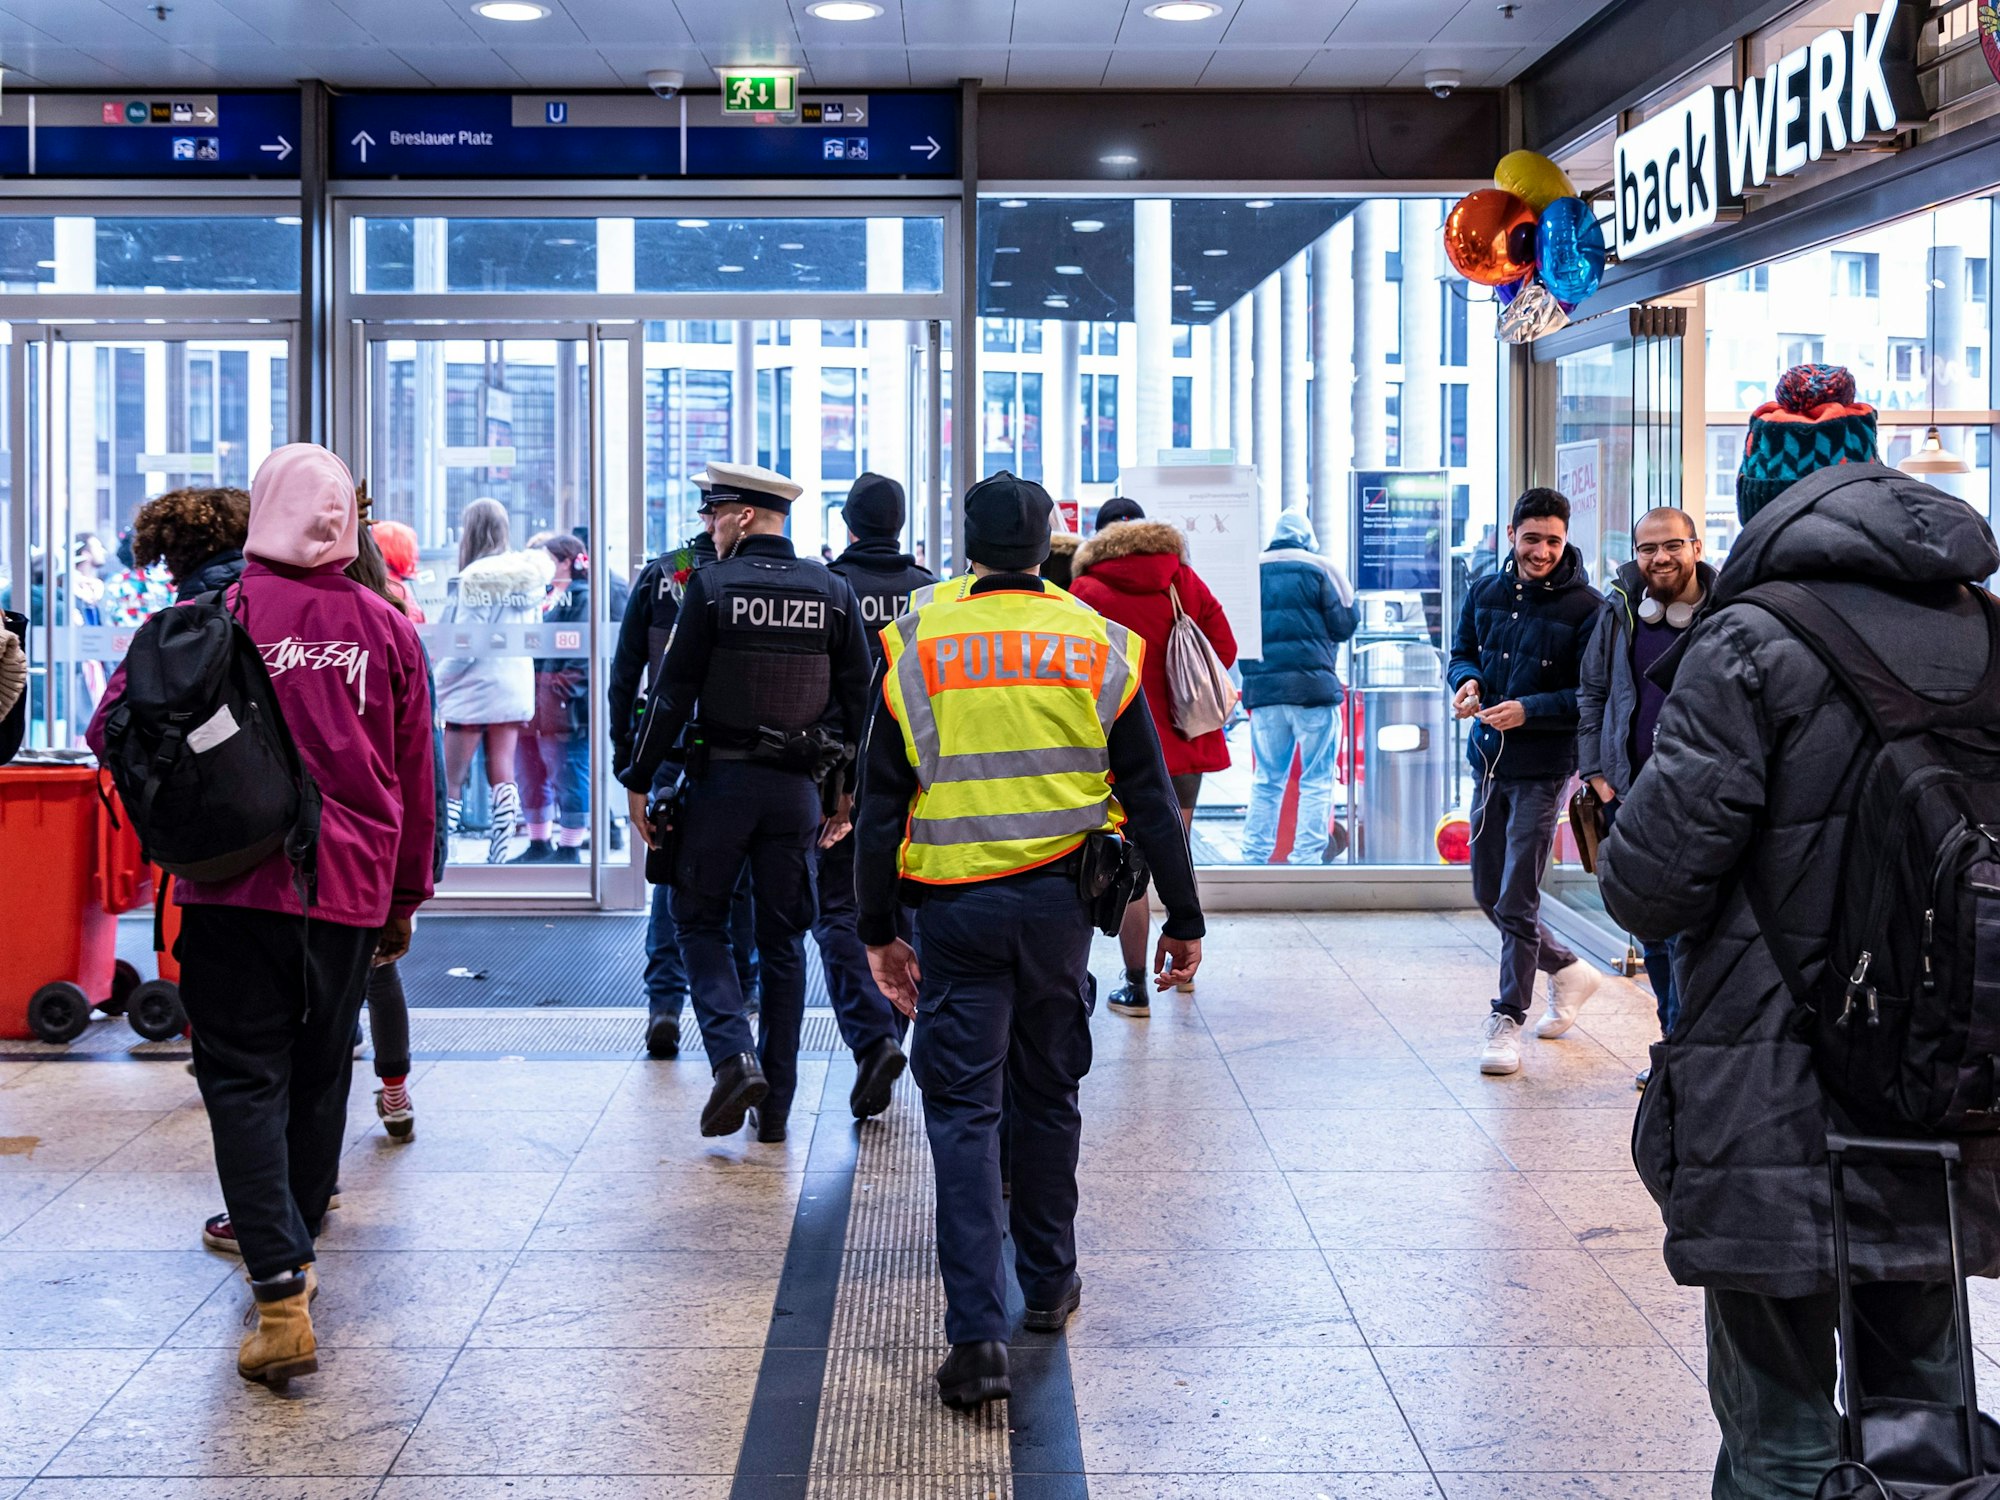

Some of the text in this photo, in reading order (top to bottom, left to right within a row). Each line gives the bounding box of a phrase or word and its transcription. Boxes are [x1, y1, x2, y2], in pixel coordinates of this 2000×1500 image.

[549, 103, 564, 122] U
[803, 108, 820, 118] TAXI
[389, 130, 493, 145] Breslauer Platz
[1571, 463, 1597, 496] DEAL
[732, 595, 827, 630] POLIZEI
[856, 595, 909, 622] OLIZ
[935, 632, 1097, 685] POLIZEI
